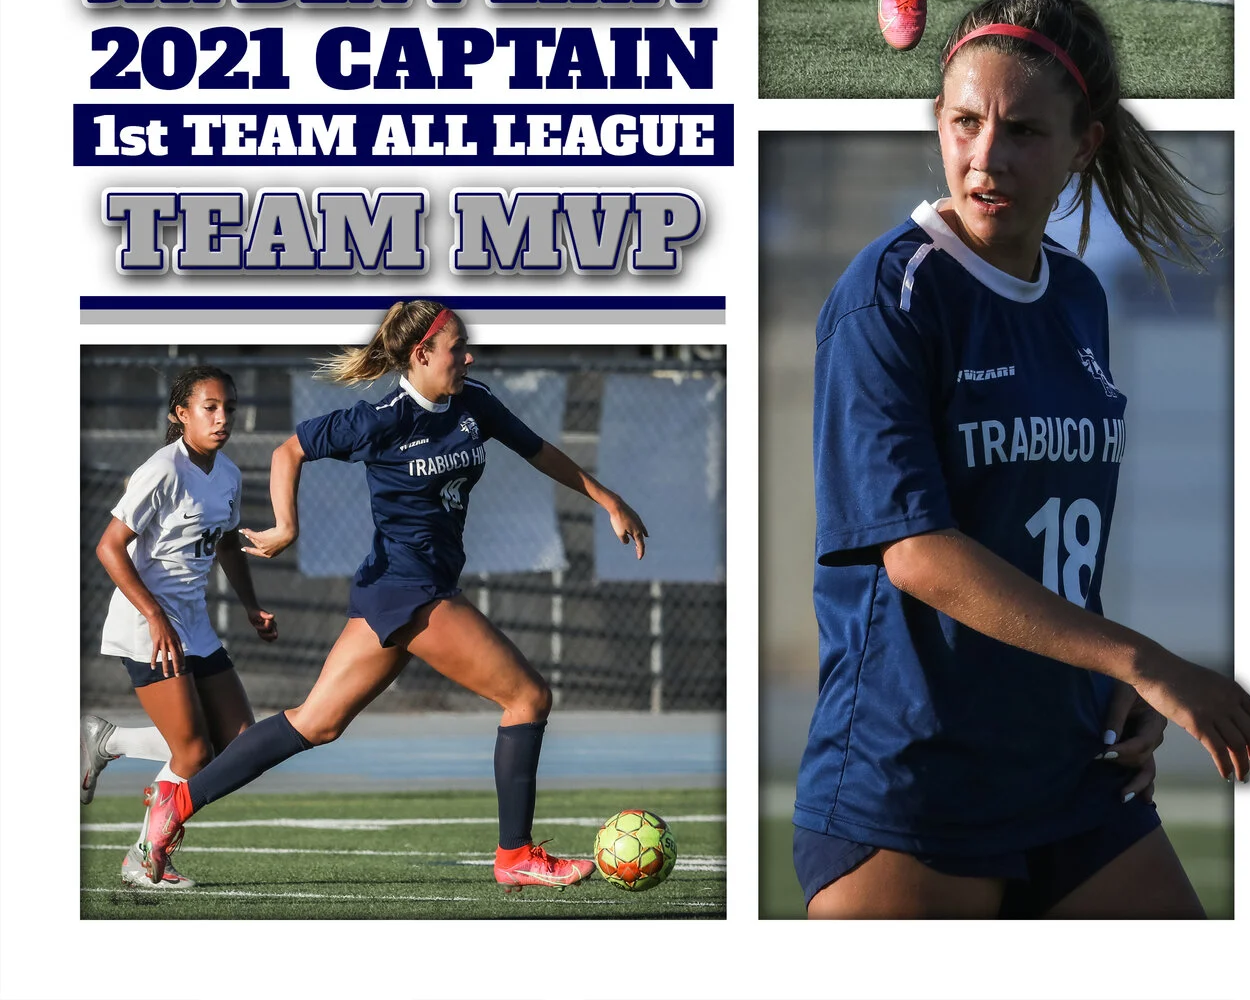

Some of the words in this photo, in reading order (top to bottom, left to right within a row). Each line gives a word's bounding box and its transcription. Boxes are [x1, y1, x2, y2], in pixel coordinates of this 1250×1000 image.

[408, 450, 469, 477] TRABUCO
[958, 416, 1095, 468] TRABUCO
[1025, 497, 1101, 609] 18
